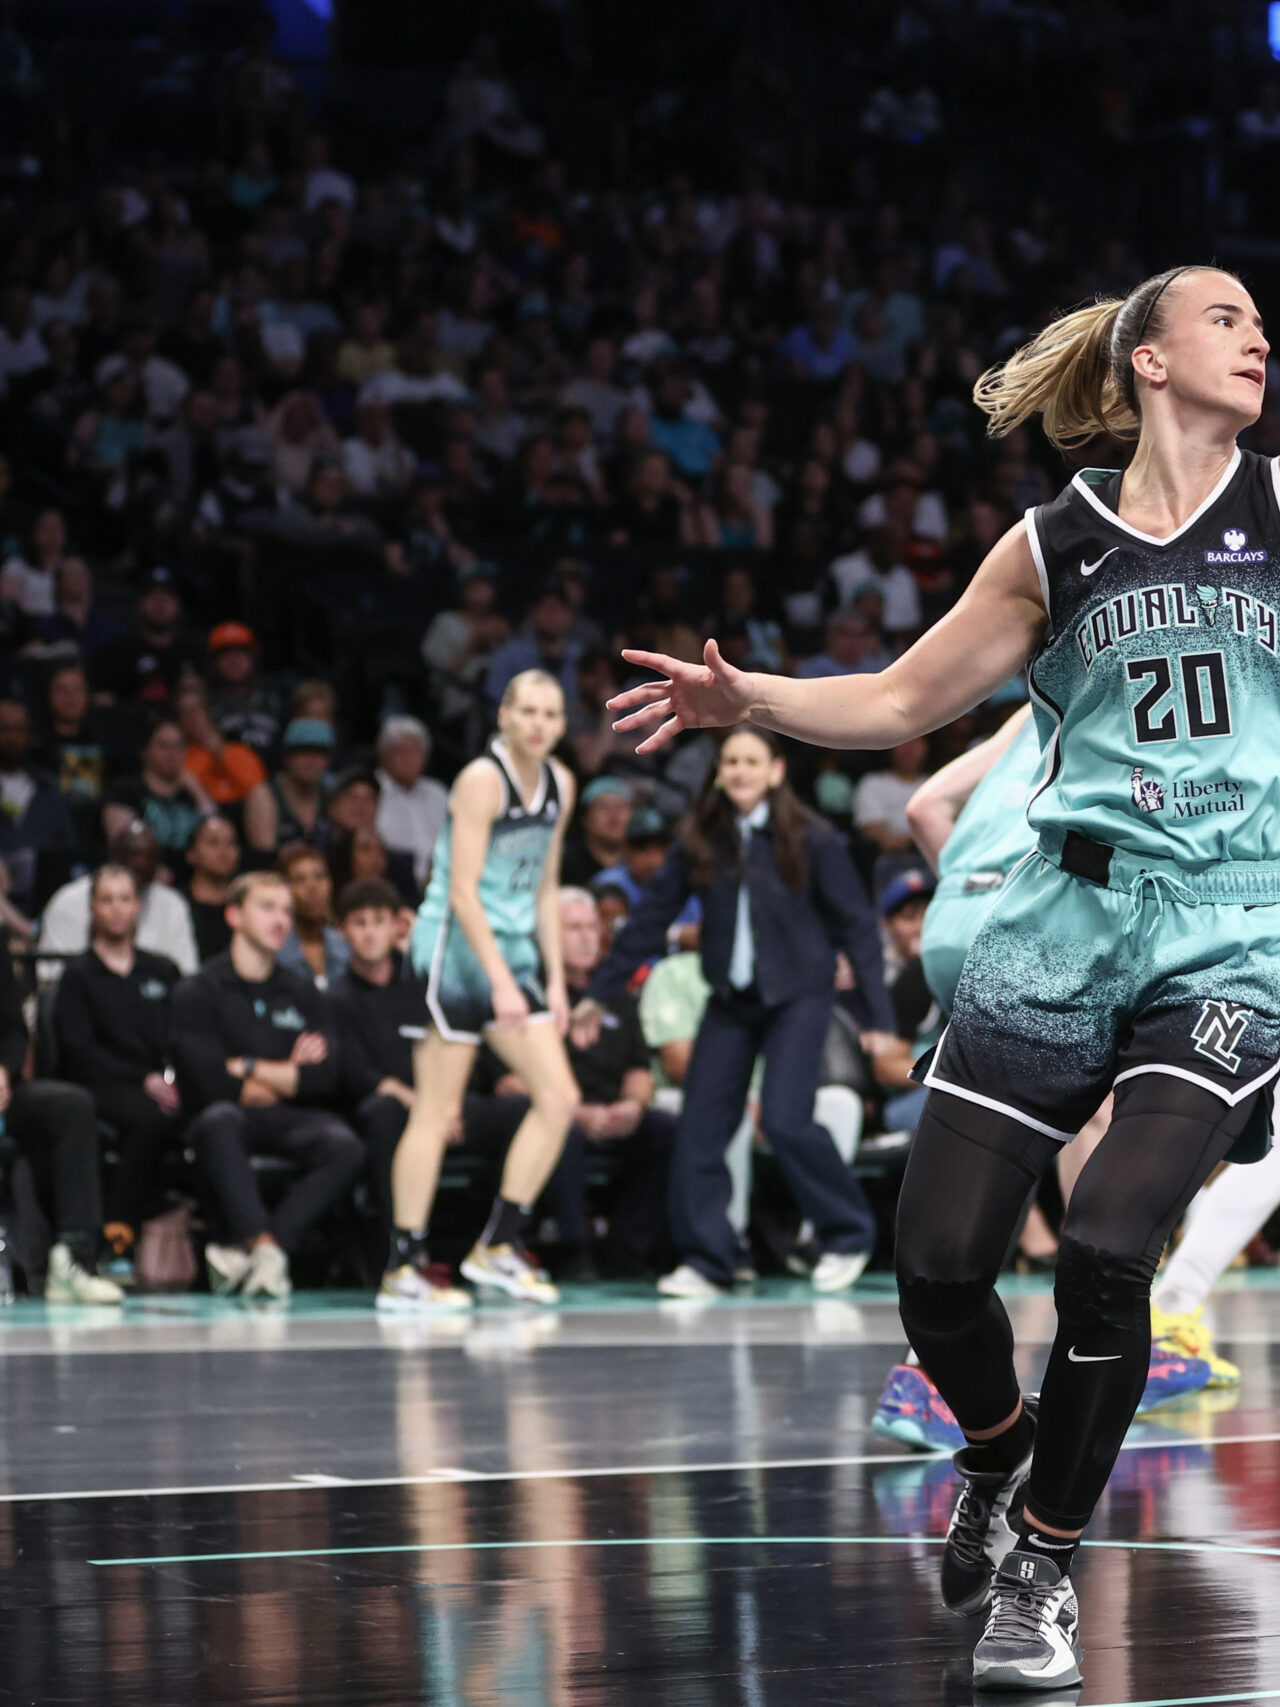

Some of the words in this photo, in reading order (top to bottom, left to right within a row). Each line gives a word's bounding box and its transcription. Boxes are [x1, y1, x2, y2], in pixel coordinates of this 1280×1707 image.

[1207, 551, 1264, 563] BARCLAYS
[1127, 652, 1232, 744] 20
[1173, 780, 1242, 798] Liberty
[1173, 794, 1245, 818] Mutual
